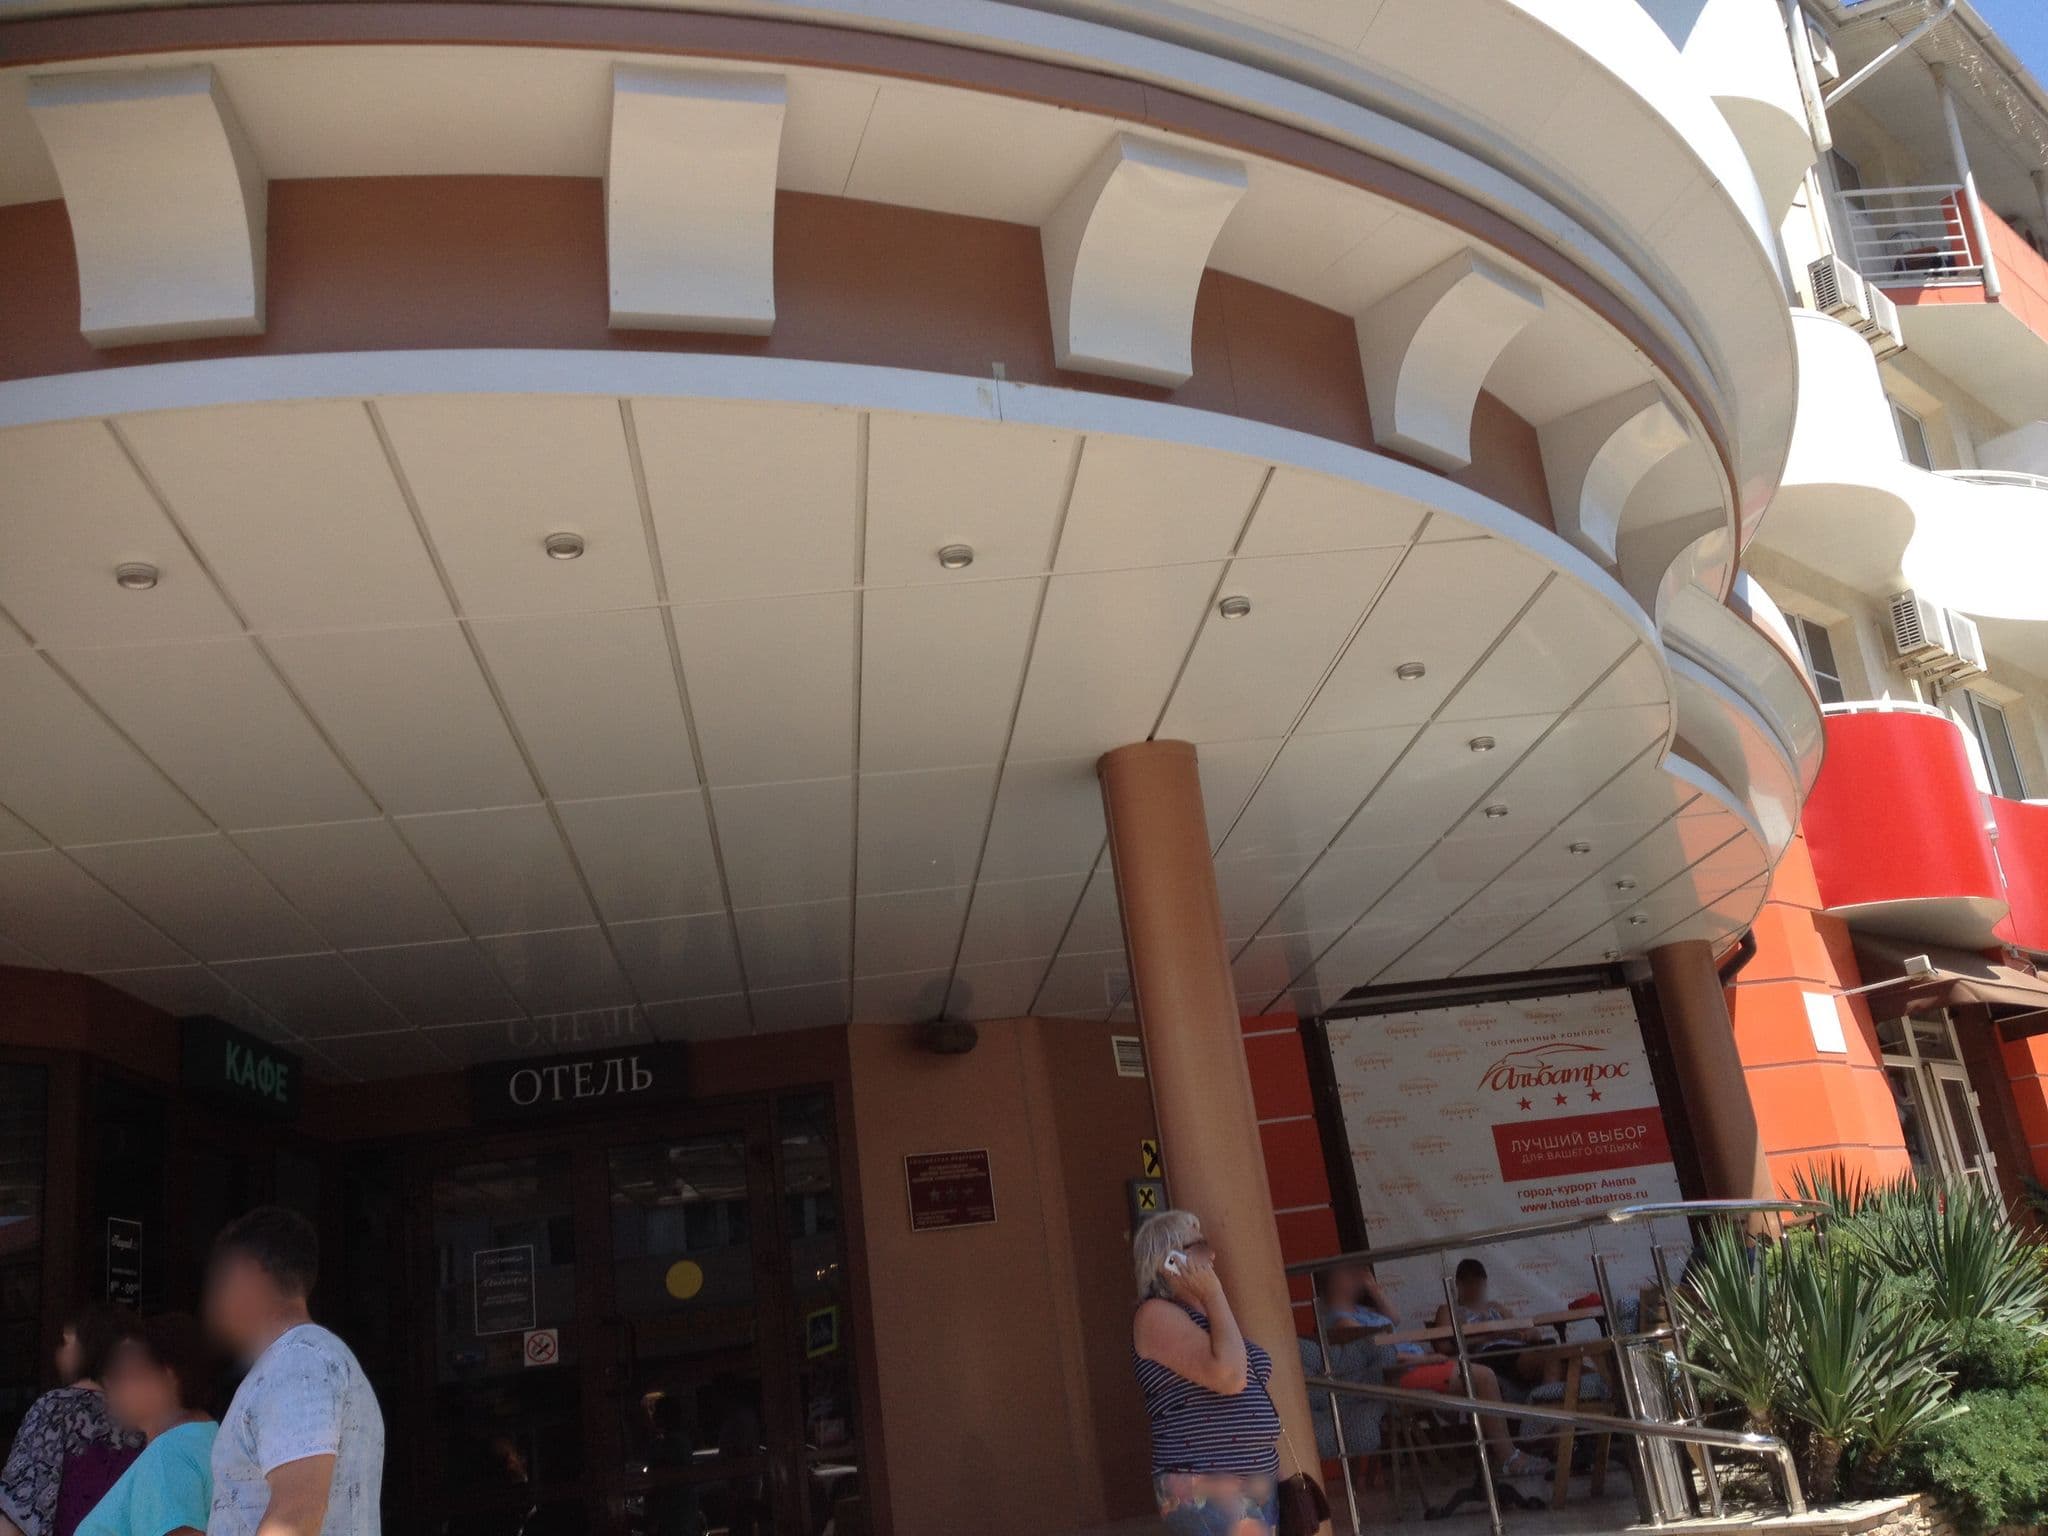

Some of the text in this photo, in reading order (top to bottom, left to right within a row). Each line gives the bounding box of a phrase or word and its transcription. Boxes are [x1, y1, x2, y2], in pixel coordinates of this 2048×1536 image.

[225, 1040, 288, 1102] КАФЕ
[509, 1056, 654, 1105] ОТЕЛЬ
[1491, 1062, 1630, 1091] Альбатрос
[1511, 1125, 1647, 1153] ЛУЧШИЙ ВЫБОР
[1521, 1153, 1544, 1164] ДЛЯ
[1548, 1147, 1592, 1161] ВАШЕГО
[1517, 1177, 1636, 1201] город-курорт Анапа
[1520, 1190, 1648, 1214] www.hotel-albatros.ru
